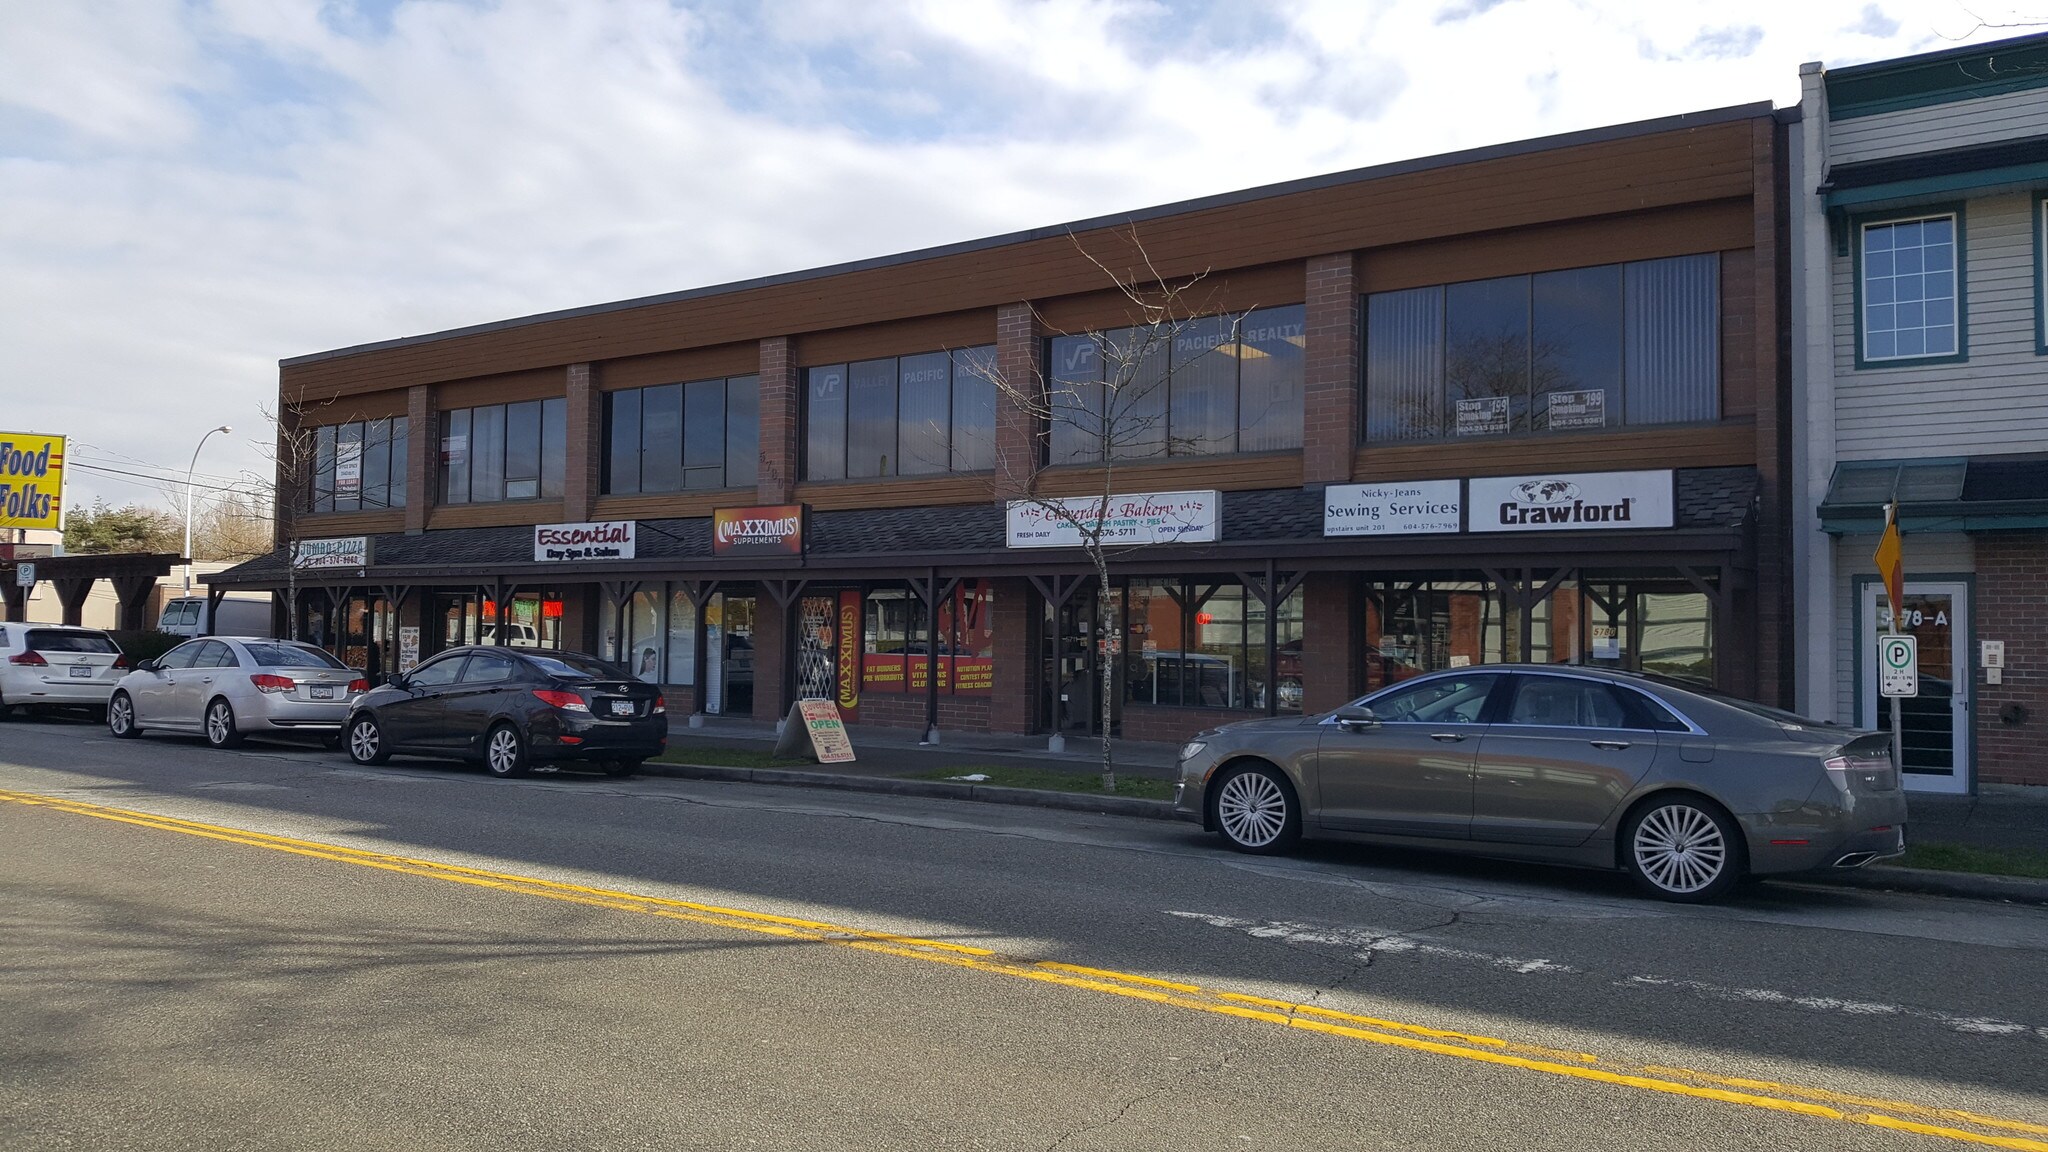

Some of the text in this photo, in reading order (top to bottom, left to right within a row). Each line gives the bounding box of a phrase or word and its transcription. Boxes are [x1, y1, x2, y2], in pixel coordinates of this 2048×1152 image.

[1247, 323, 1302, 343] REALTY
[904, 368, 944, 384] PACIFIC
[1459, 402, 1481, 411] Stop
[1551, 394, 1575, 404] Stop
[0, 442, 51, 478] Food
[0, 483, 51, 519] Folks
[1361, 488, 1422, 500] Nicky-Jeans
[1119, 495, 1174, 524] Bakery
[1327, 500, 1458, 520] Sewing Services
[1500, 498, 1632, 524] Crawford
[724, 517, 796, 537] MAXXIMUS
[1113, 518, 1138, 527] PASTRY
[1146, 517, 1161, 525] PIES
[1157, 524, 1204, 534] OPEN SUNDAY
[1326, 525, 1353, 533] upstairs
[1403, 522, 1458, 530] 604-576-7969
[537, 523, 631, 546] Essential
[733, 536, 782, 545] SUPPLEMENTS
[546, 546, 620, 561] Day Spa & Salon
[1881, 610, 1948, 626] 578-A
[1593, 626, 1617, 638] 5780
[841, 611, 854, 701] MAXXIMUS
[1894, 647, 1904, 662] P
[912, 671, 947, 679] VITANS
[811, 719, 841, 729] OPEN
